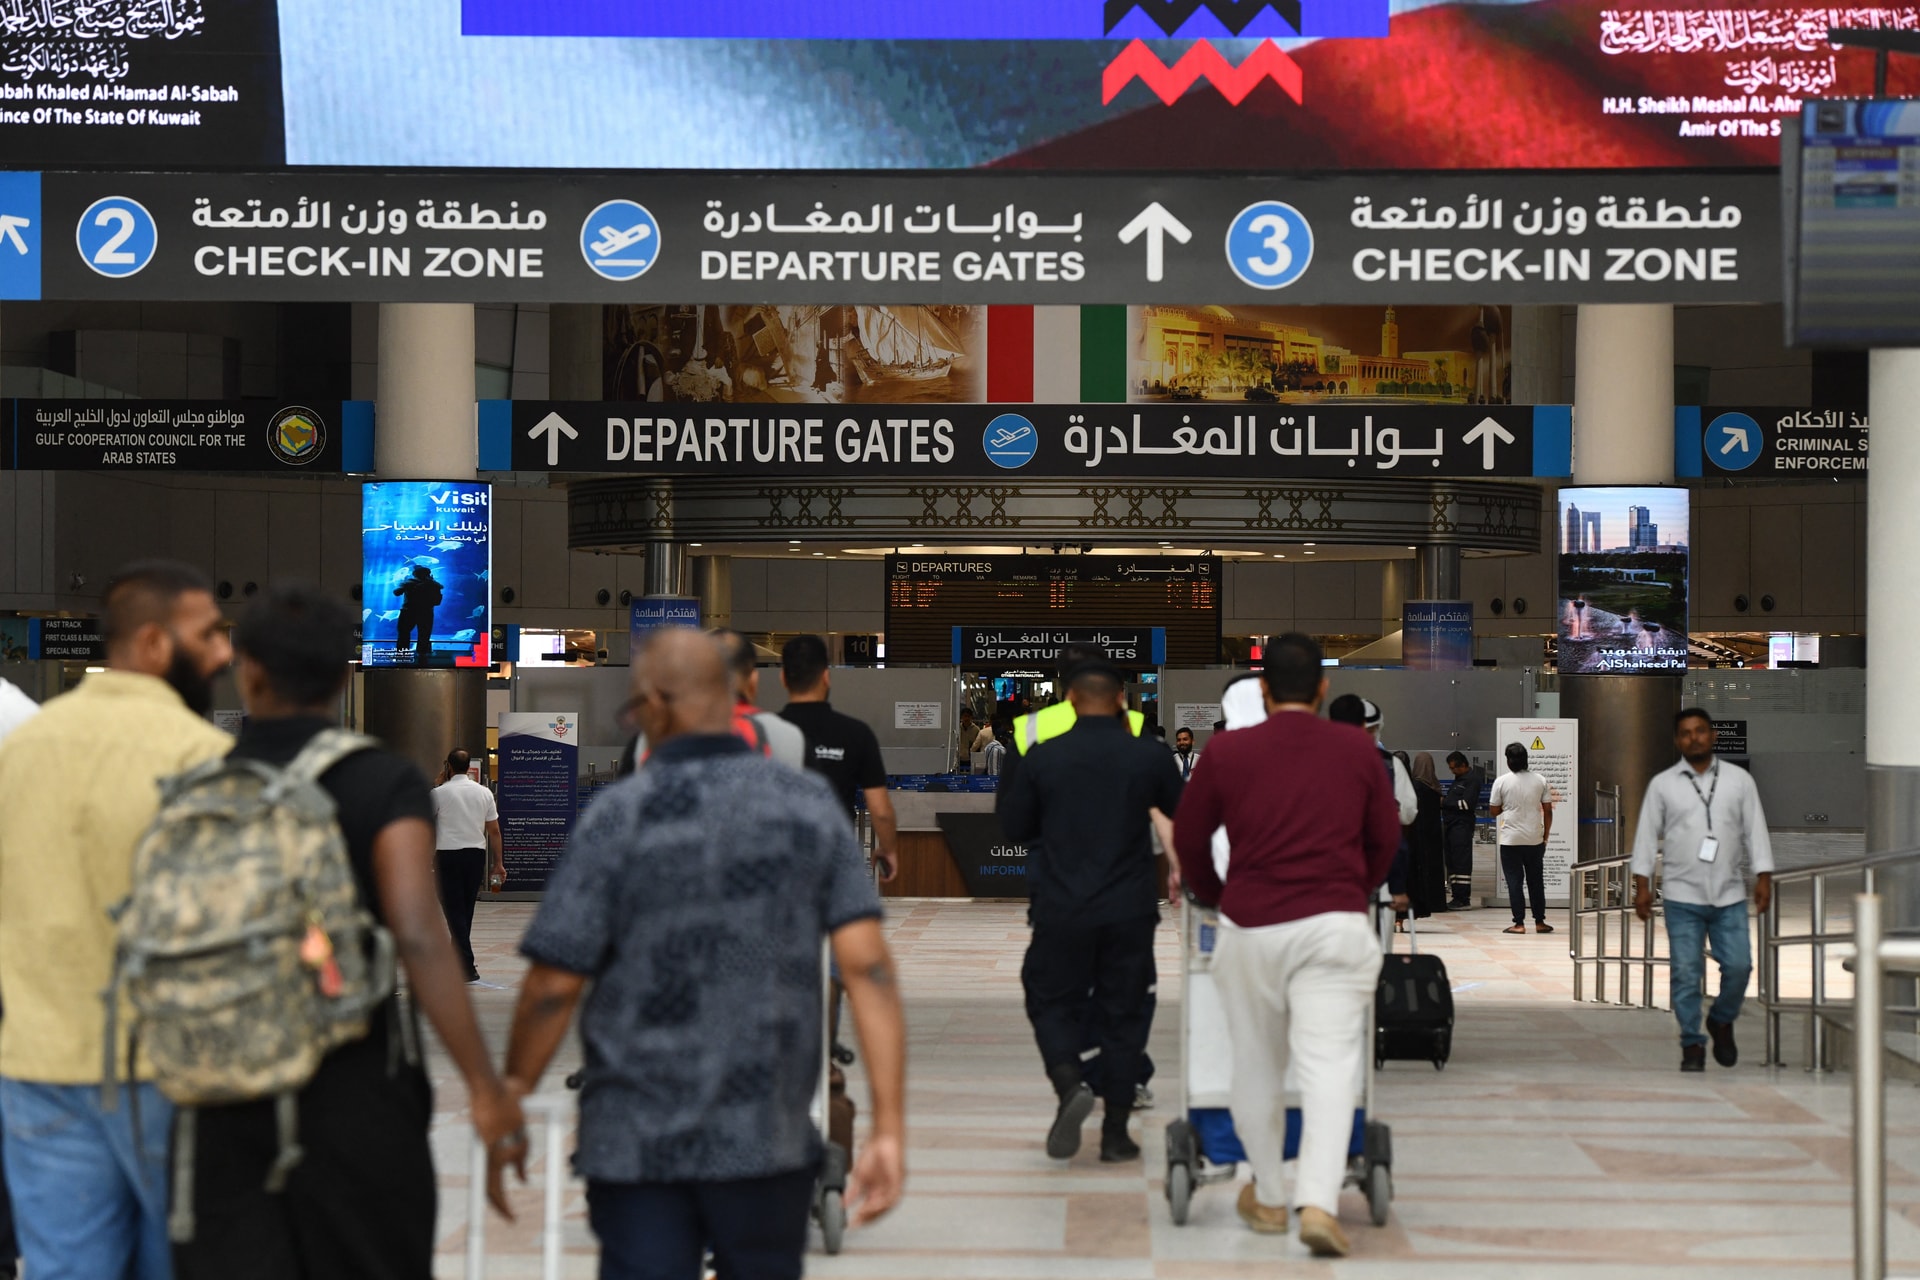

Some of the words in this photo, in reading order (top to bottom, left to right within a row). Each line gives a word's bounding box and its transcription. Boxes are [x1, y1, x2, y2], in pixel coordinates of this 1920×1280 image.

[37, 84, 89, 100] Khaled
[92, 85, 167, 101] Al-Hamad
[171, 85, 239, 102] Al-Sabah
[1603, 98, 1635, 113] H.H.
[1638, 97, 1690, 114] Sheikh
[1692, 97, 1746, 113] Meshal
[33, 108, 52, 124] Of
[53, 109, 83, 125] The
[85, 109, 124, 125] State
[127, 109, 146, 125] Of
[149, 110, 201, 125] Kuwait
[1679, 120, 1717, 137] Amir
[1719, 120, 1740, 136] Of
[1740, 120, 1768, 136] The
[1770, 119, 1782, 137] S
[192, 196, 331, 231] الأمتعة
[341, 203, 409, 235] وزن
[416, 199, 547, 232] منطقة
[703, 201, 892, 239] المغادرة
[1350, 194, 1502, 231] الأمتعة
[1513, 202, 1588, 236] وزن
[1595, 198, 1741, 231] منطقة
[904, 203, 1083, 243] بوابات
[93, 208, 136, 265] 2
[1246, 213, 1291, 277] 3
[193, 245, 411, 277] CHECK-IN
[423, 246, 544, 278] ZONE
[701, 251, 941, 281] DEPARTURE
[953, 250, 1086, 282] GATES
[1352, 248, 1590, 282] CHECK-IN
[1603, 248, 1738, 282] ZONE
[36, 408, 71, 426] العربية
[74, 408, 103, 428] الخليج
[107, 409, 130, 427] لدول
[133, 409, 170, 427] التعاون
[173, 409, 205, 427] مجلس
[208, 410, 245, 428] مواطنو
[1776, 409, 1844, 433] الأحكام
[36, 433, 65, 446] GULF
[68, 433, 146, 446] COOPERATION
[149, 434, 197, 446] COUNCIL
[200, 434, 222, 446] FOR
[224, 434, 246, 446] THE
[606, 418, 824, 463] DEPARTURE
[835, 418, 955, 464] GATES
[1064, 414, 1256, 467] المغادرة
[1270, 415, 1443, 469] بوابات
[1776, 438, 1854, 451] CRIMINAL
[1858, 438, 1869, 452] S
[102, 452, 133, 464] ARAB
[136, 452, 176, 464] STATES
[1775, 456, 1870, 470] ENFORCEM
[429, 490, 488, 506] Visit
[446, 520, 488, 535] دليلك
[395, 534, 436, 543] واحدة
[439, 532, 472, 542] منصة
[474, 534, 487, 545] في
[912, 562, 992, 573] DEPARTURES
[1117, 564, 1195, 576] المغادرة
[851, 640, 867, 653] 10
[976, 632, 1050, 647] المغادرة
[980, 865, 1026, 875] INFORM
